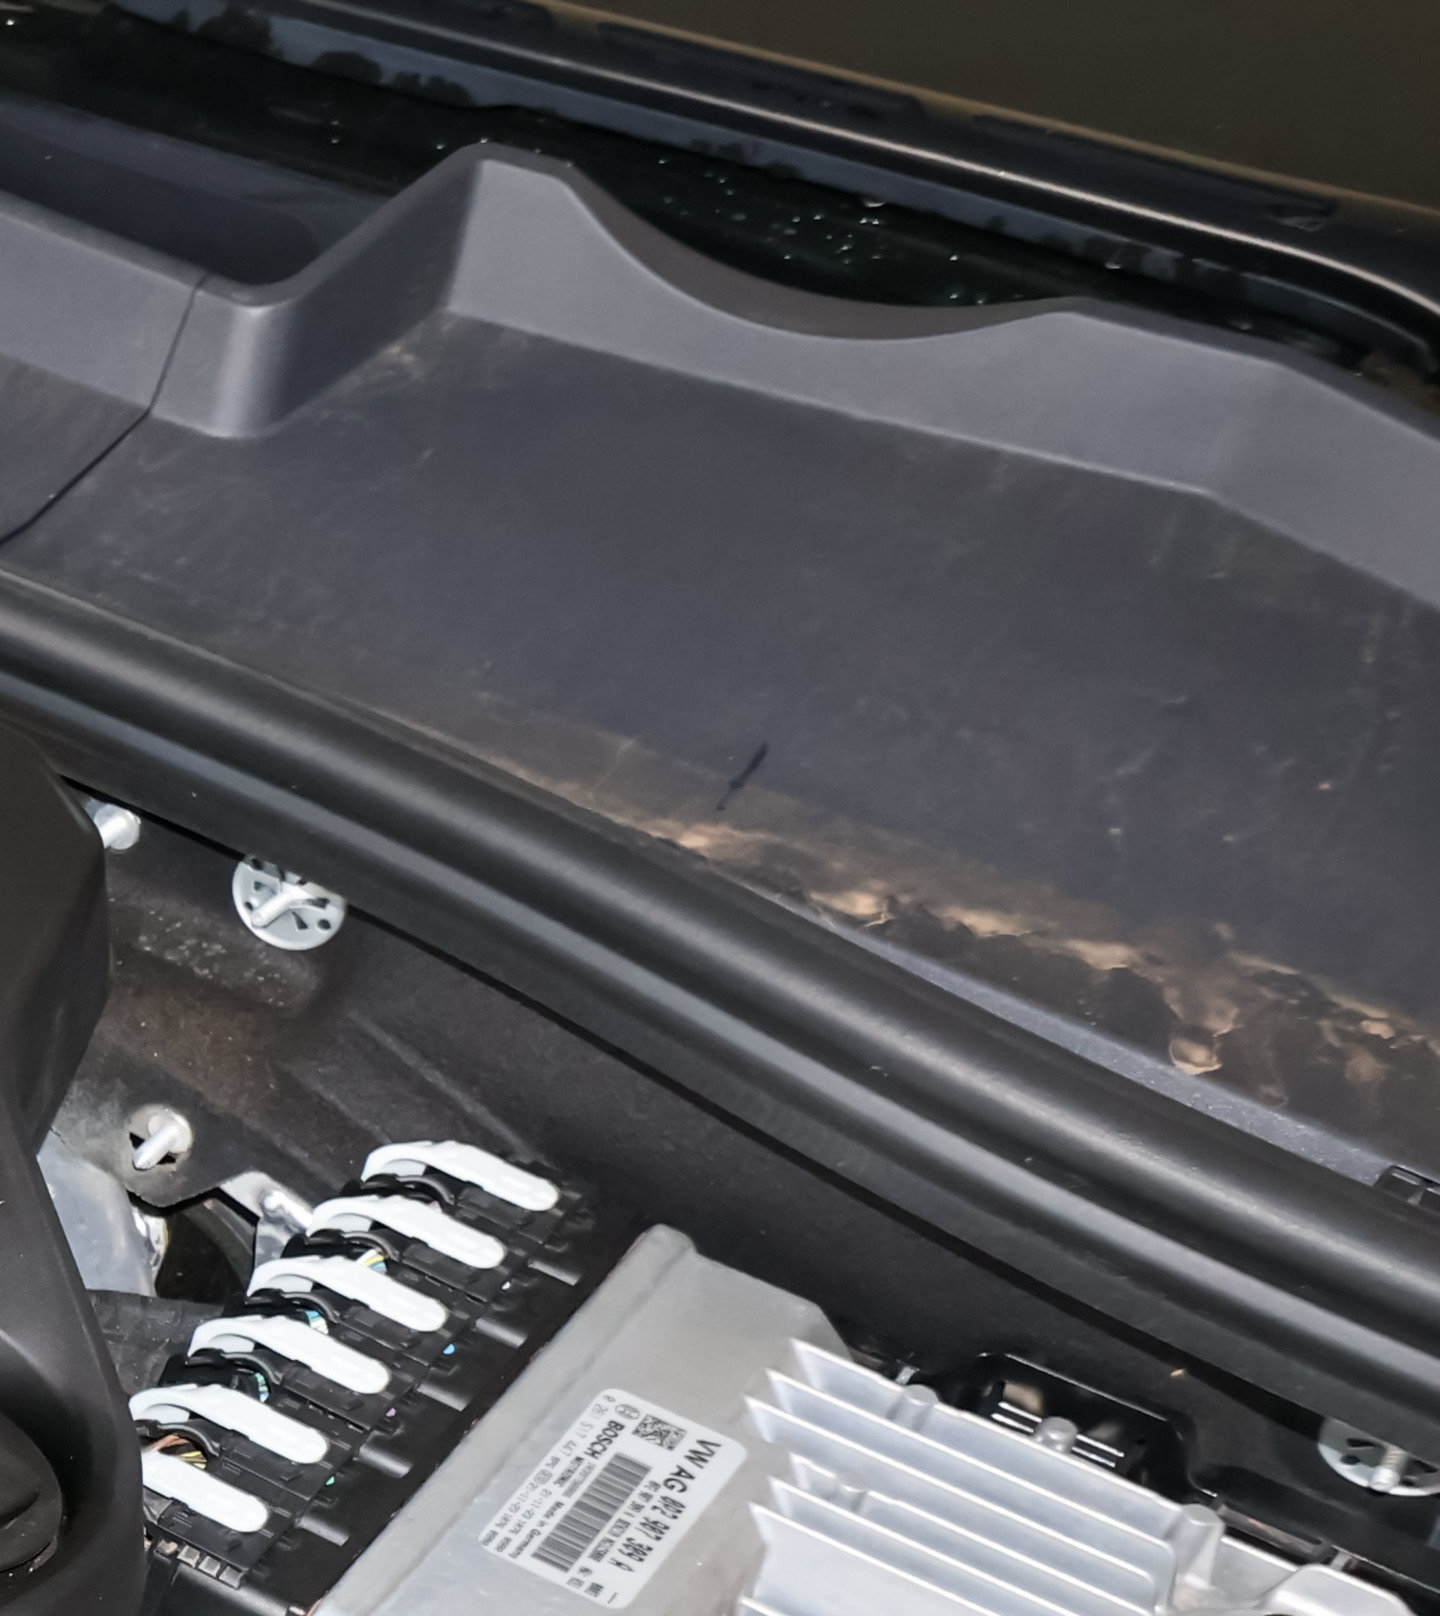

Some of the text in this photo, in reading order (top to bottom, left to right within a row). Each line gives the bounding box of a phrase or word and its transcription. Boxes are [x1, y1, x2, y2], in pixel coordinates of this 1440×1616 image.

[583, 1418, 626, 1459] BOSCH
[661, 1437, 722, 1494] VW AG
[542, 1500, 564, 1519] Made
[507, 1527, 541, 1560] Germany
